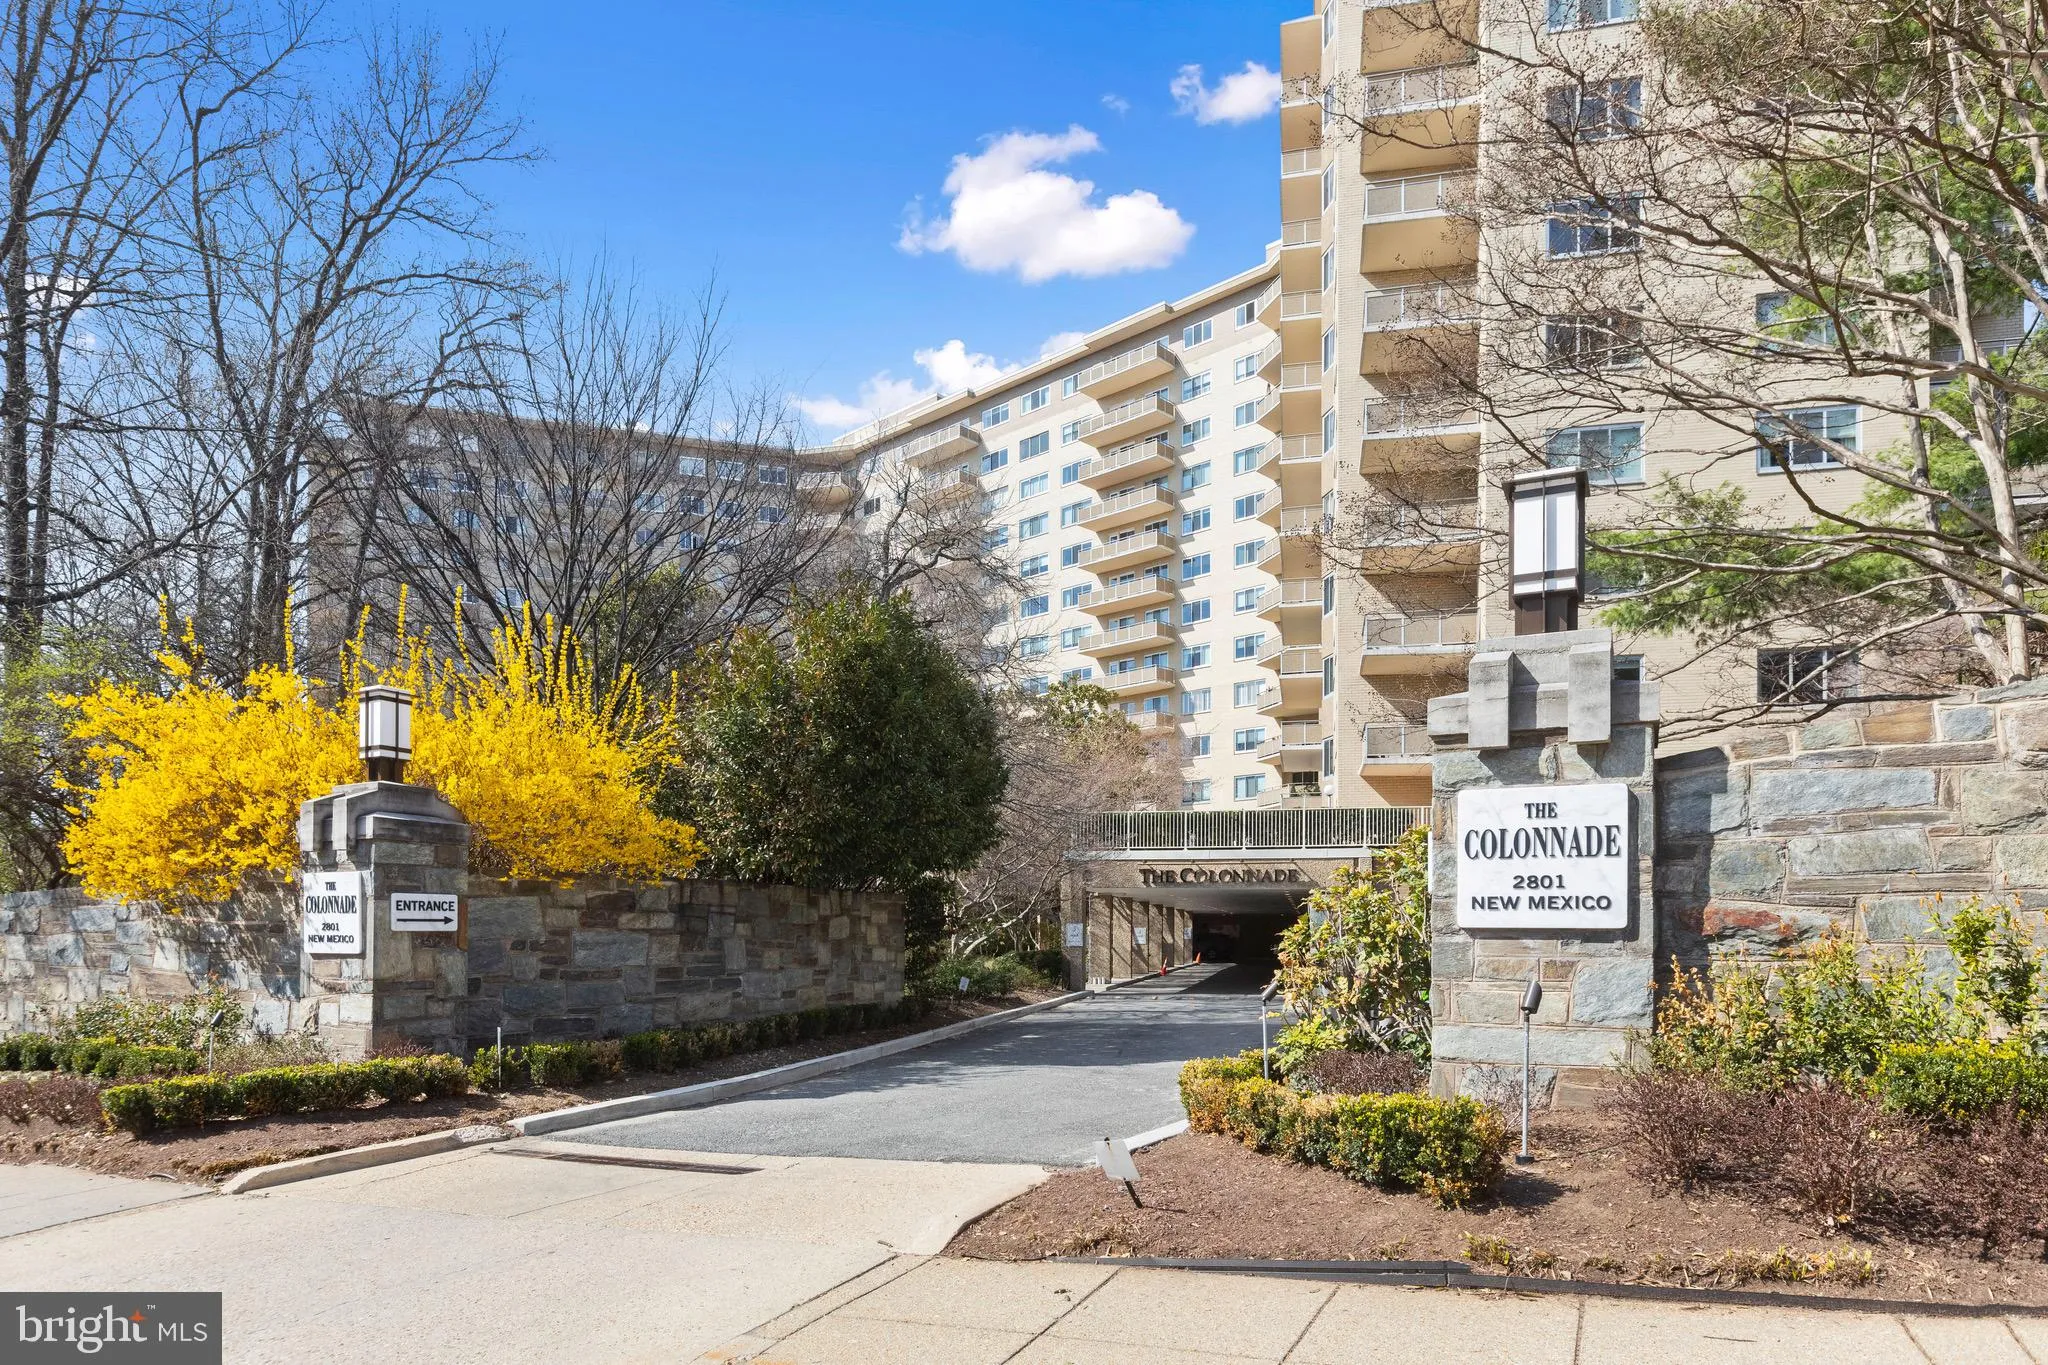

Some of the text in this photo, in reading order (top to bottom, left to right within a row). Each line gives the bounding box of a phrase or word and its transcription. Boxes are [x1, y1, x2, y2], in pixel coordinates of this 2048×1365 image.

[1524, 802, 1558, 819] THE
[1464, 825, 1621, 860] COLONNADE
[1139, 868, 1300, 884] THE COLONNADE
[1512, 874, 1566, 889] 2801
[325, 881, 337, 891] THE
[305, 895, 357, 914] COLONNADE
[395, 900, 455, 912] ENTRANCE
[1471, 895, 1613, 910] NEW MEXICO
[321, 922, 340, 932] 2801
[308, 934, 354, 944] NEW MEXICO
